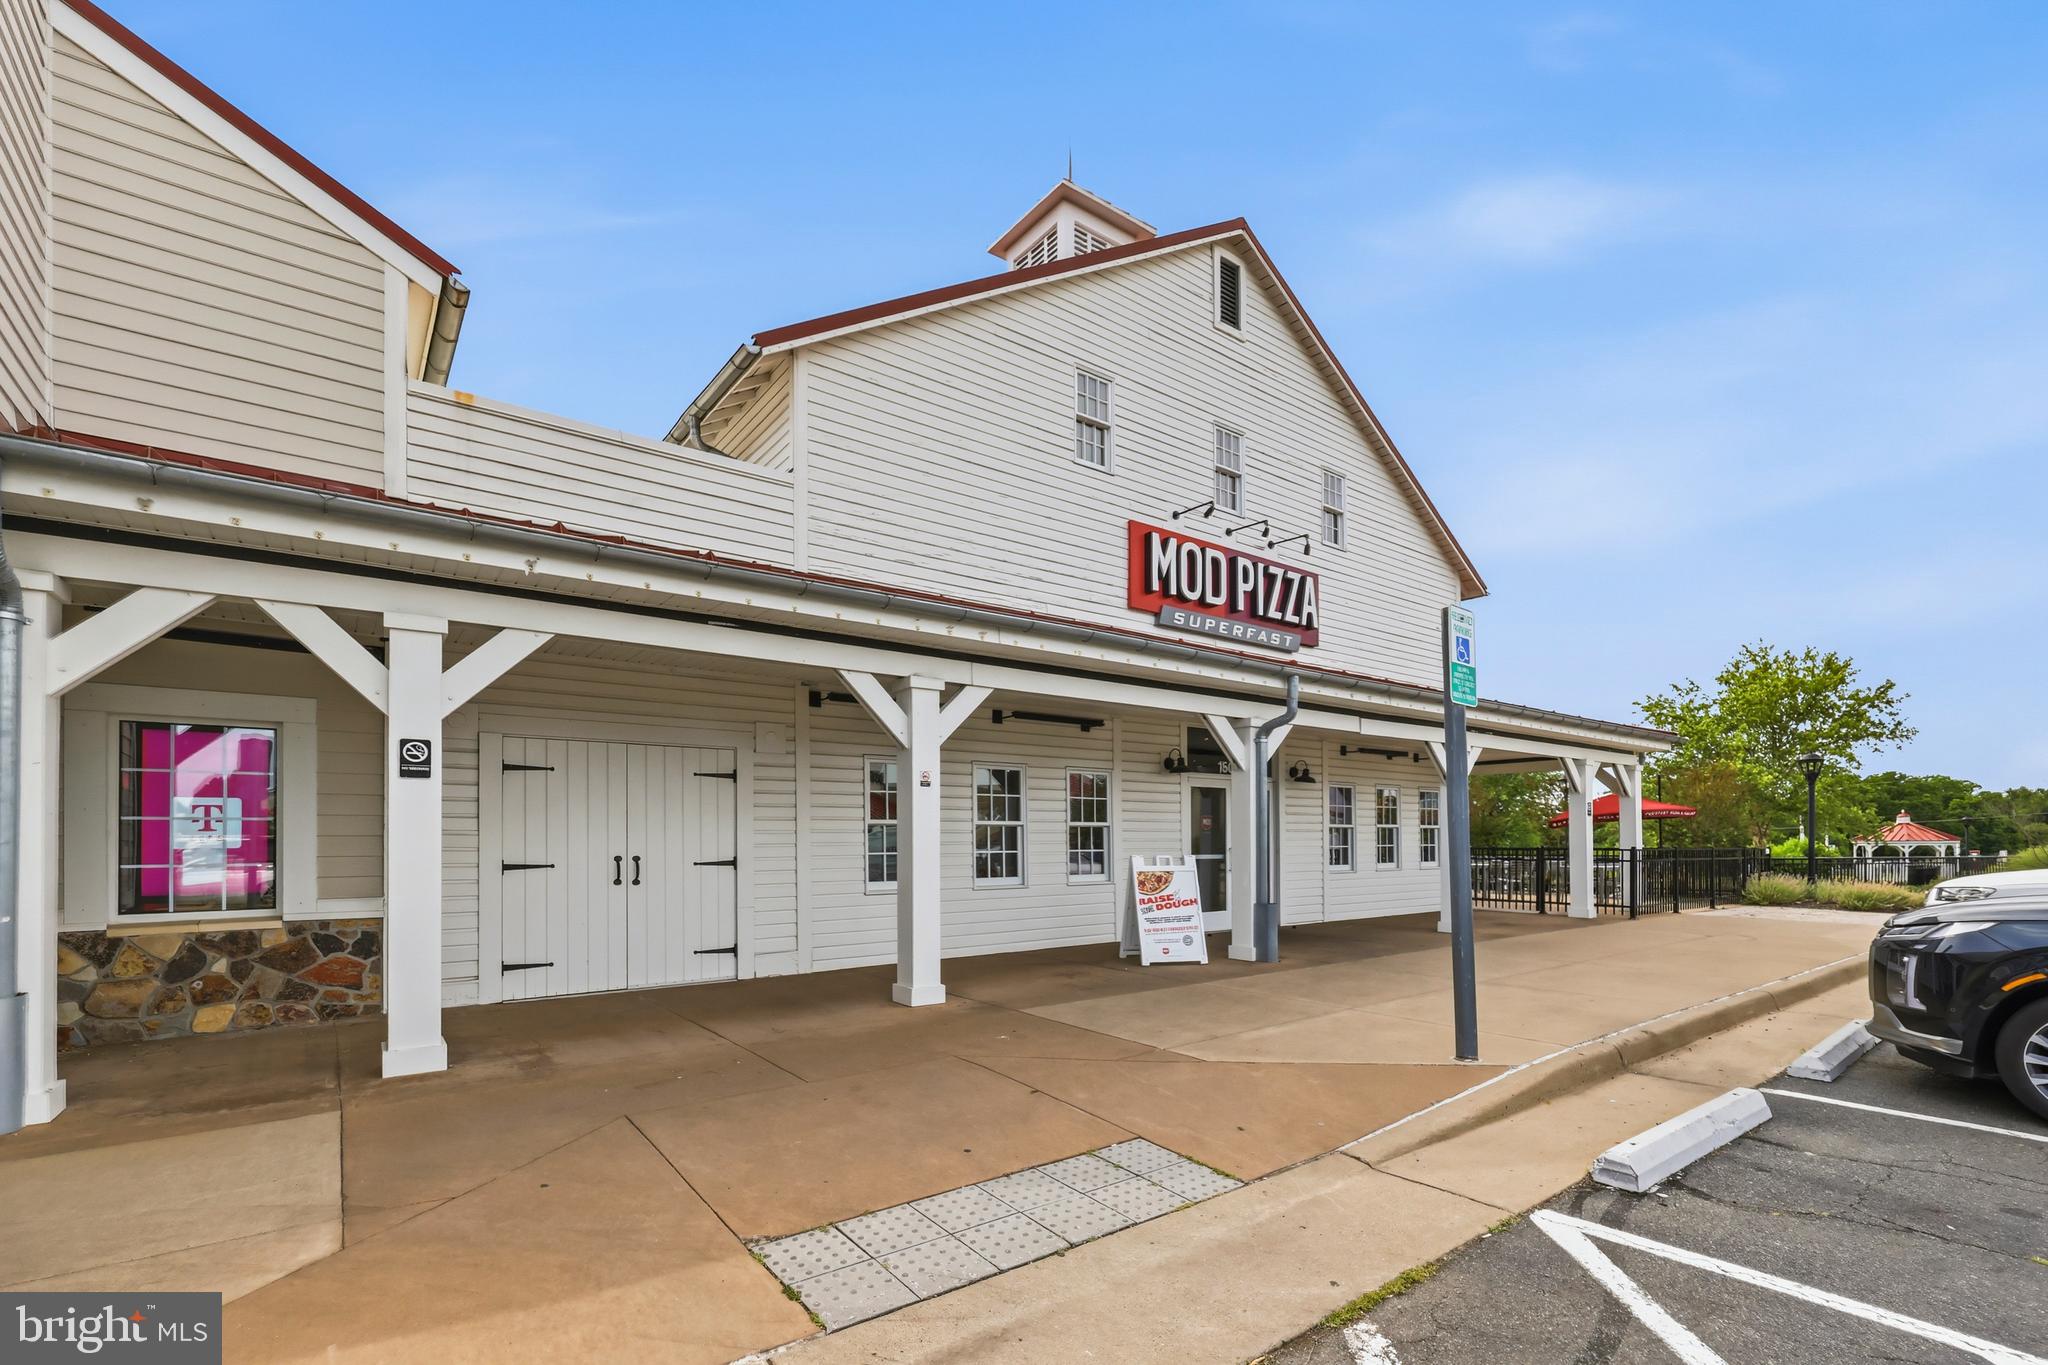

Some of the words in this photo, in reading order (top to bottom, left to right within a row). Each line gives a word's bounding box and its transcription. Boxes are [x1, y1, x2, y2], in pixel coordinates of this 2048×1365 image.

[1145, 531, 1227, 606] MOD
[1232, 555, 1319, 629] PIZZA
[1173, 611, 1294, 648] SUPERFAST
[191, 804, 223, 832] T
[1139, 894, 1174, 905] RAISE
[1155, 898, 1198, 911] DOUGH
